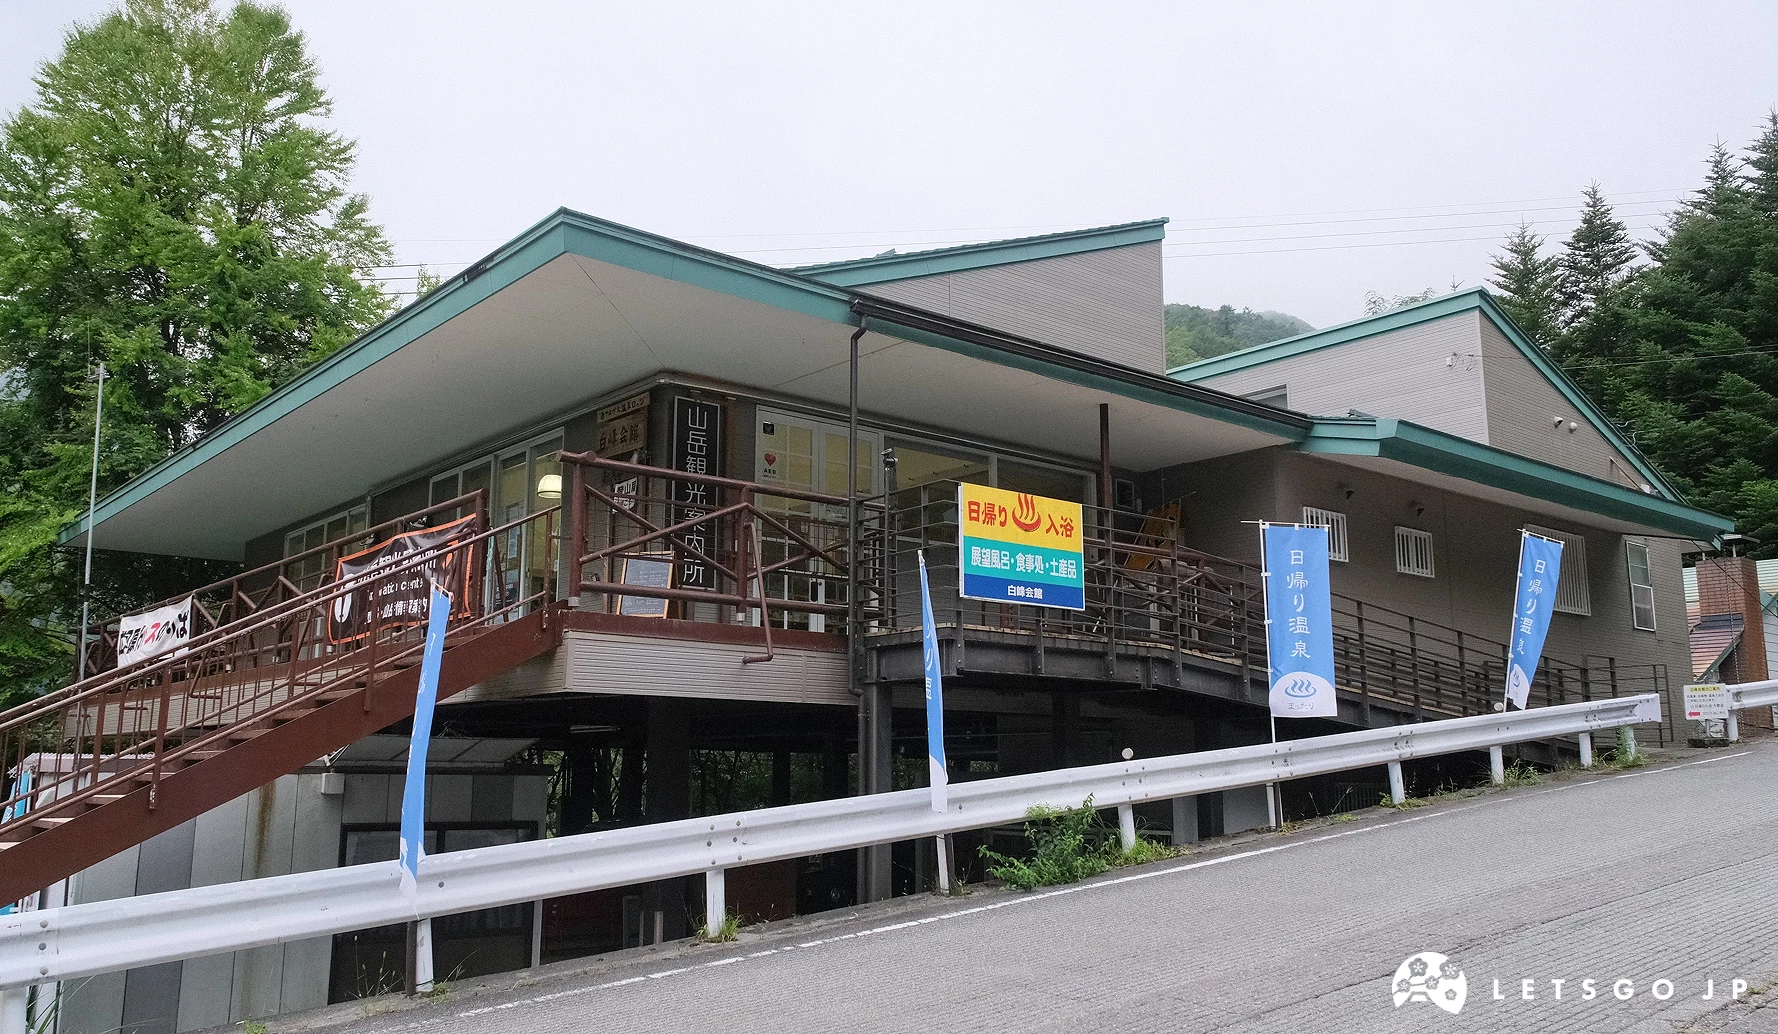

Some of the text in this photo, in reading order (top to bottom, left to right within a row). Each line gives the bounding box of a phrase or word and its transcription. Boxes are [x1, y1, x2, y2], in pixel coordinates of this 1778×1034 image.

[599, 424, 640, 452] 白峰会館
[682, 405, 708, 584] 山岳観光案内所
[967, 500, 1075, 539] 日帰り 入浴
[970, 545, 1077, 579] 展望風呂・食事処・土産品
[1007, 584, 1043, 600] 白峰会館
[1286, 549, 1312, 659] 日帰り温泉
[1287, 701, 1315, 710] まったり
